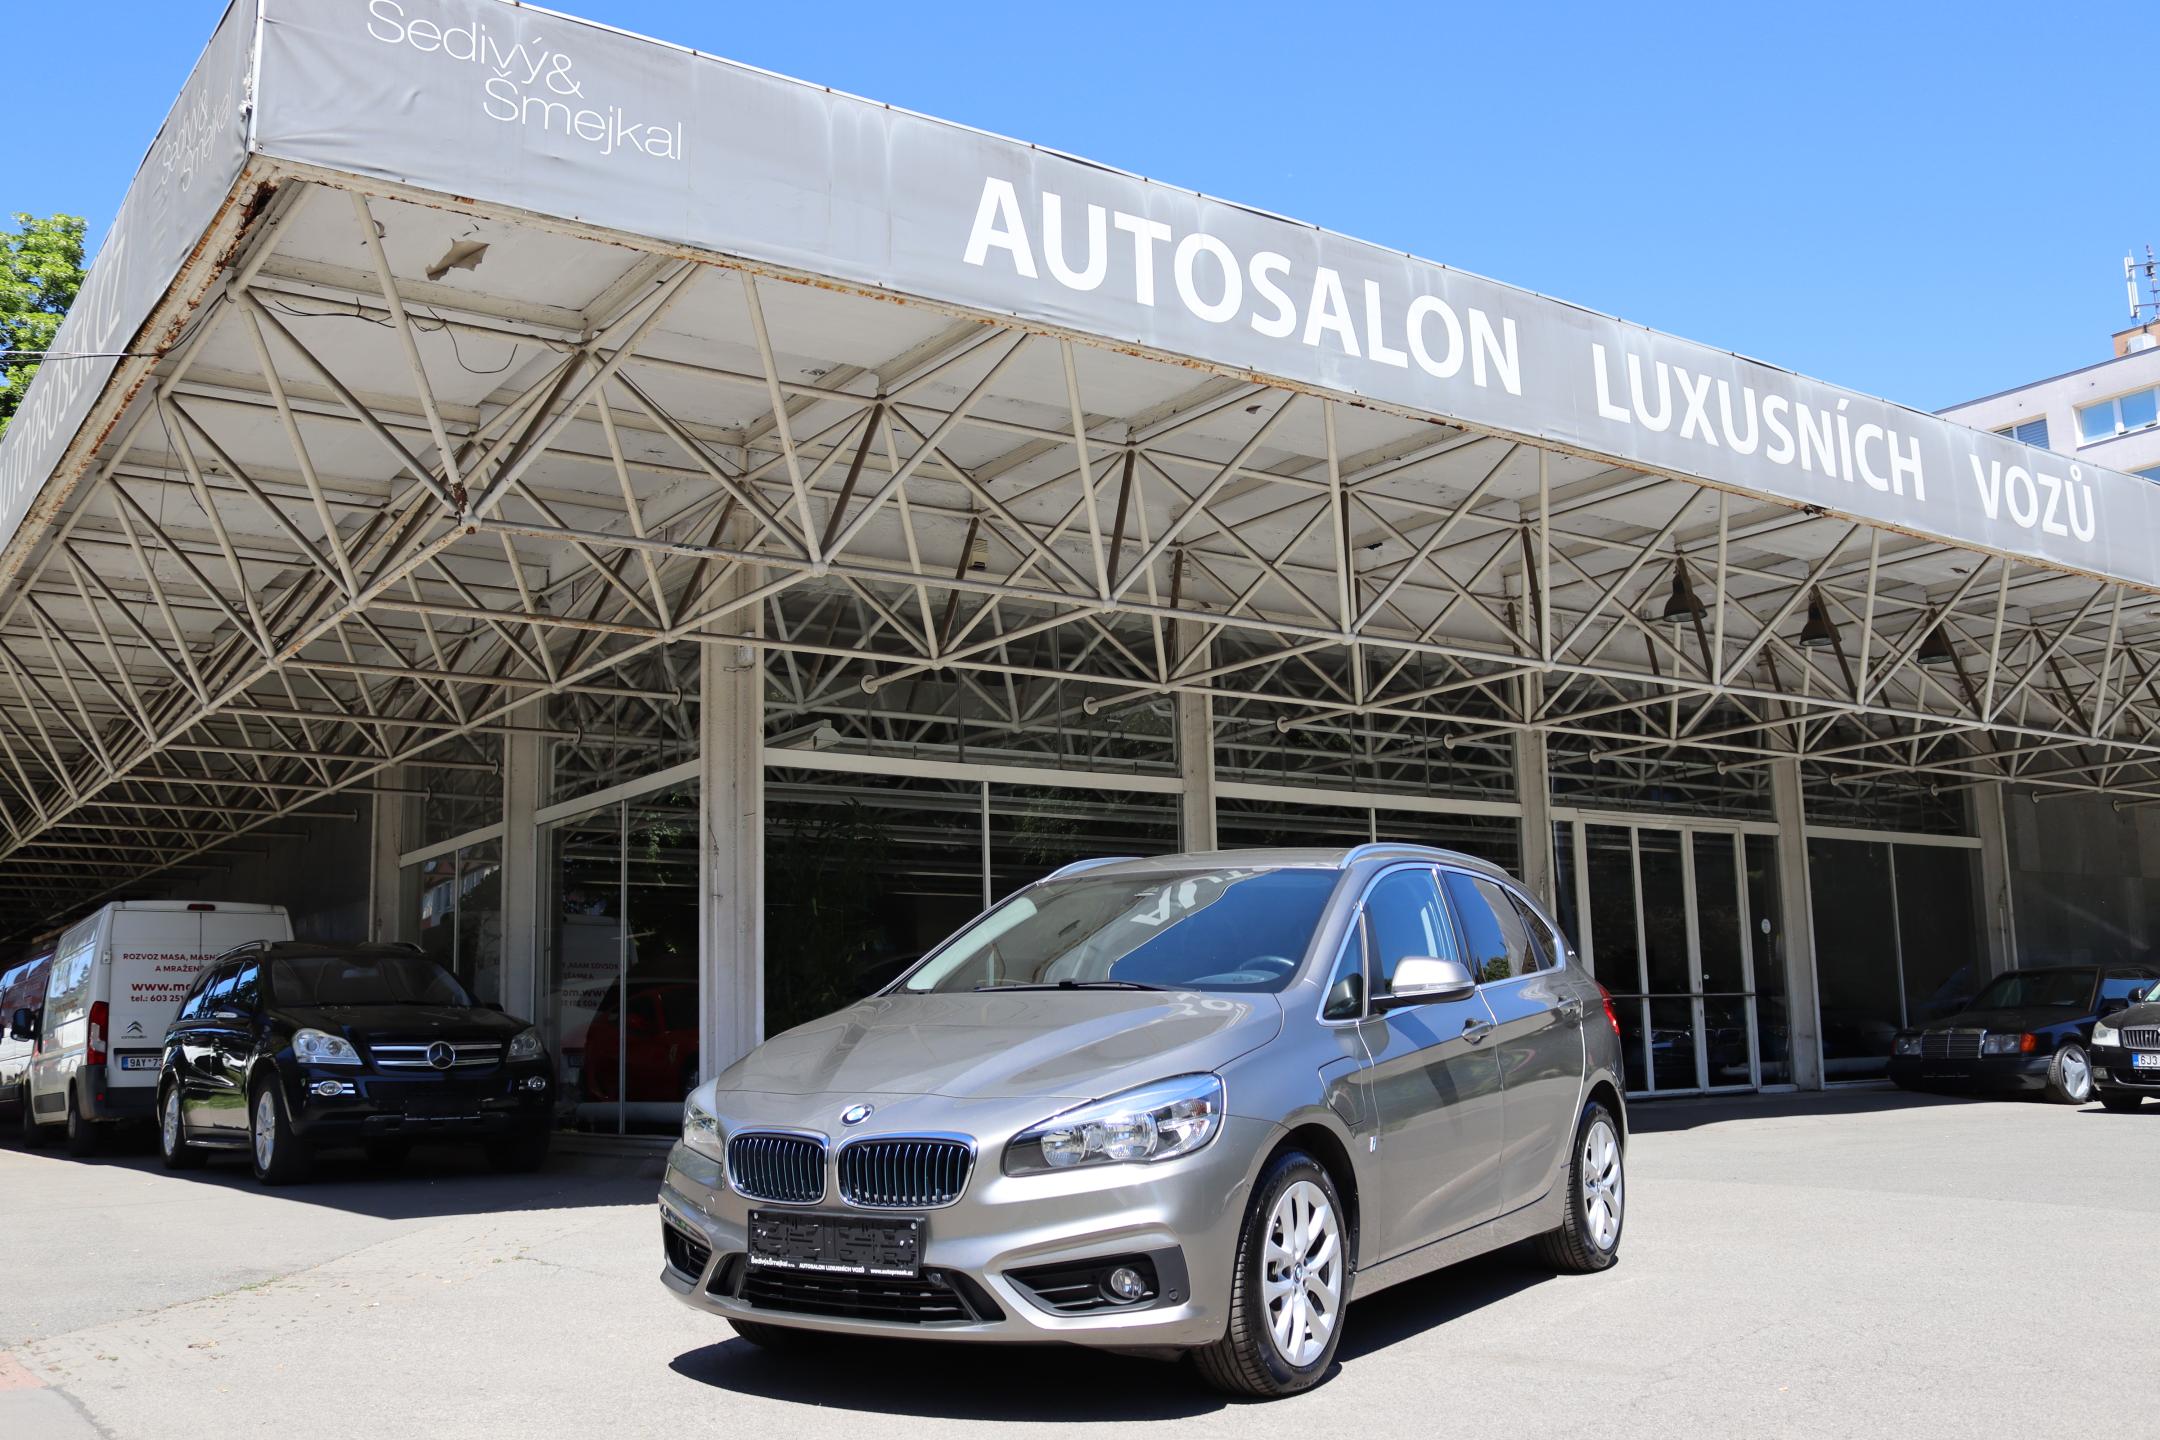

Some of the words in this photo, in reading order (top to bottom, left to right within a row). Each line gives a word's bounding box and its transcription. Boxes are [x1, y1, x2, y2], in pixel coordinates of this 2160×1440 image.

[482, 65, 682, 160] Šmejkal
[963, 176, 1522, 396] AUTOSALON
[1591, 343, 1926, 501] LUXUSNÍCH
[1968, 453, 2096, 543] VOZŮ
[123, 953, 159, 961] ROZVOZ
[190, 953, 219, 961] MASN
[163, 963, 204, 973] MRAŽEN
[150, 994, 168, 1002] 603
[129, 1058, 146, 1067] 9AY
[2140, 1055, 2158, 1065] 6J3
[799, 1262, 825, 1271] AUTOSALON
